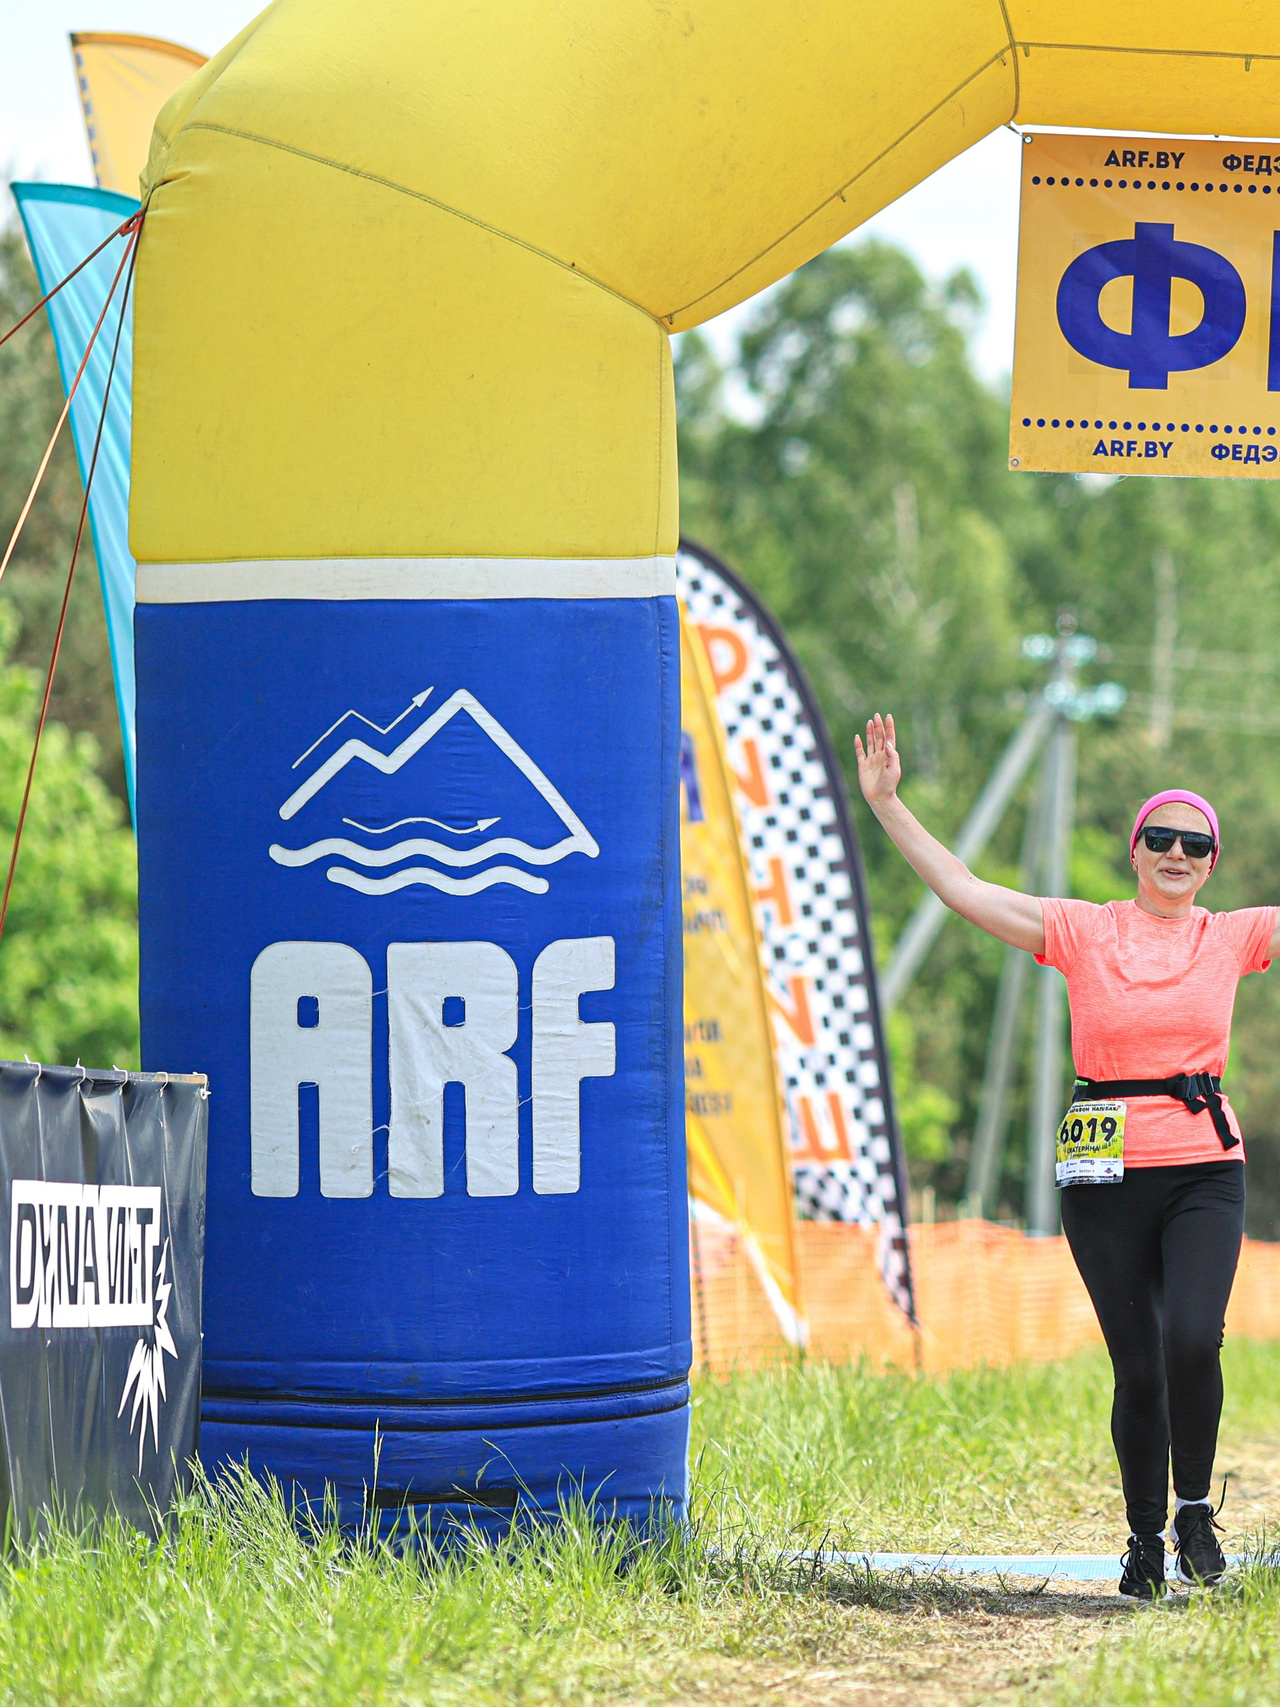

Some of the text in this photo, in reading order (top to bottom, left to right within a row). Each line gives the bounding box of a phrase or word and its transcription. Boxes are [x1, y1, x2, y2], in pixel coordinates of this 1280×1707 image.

[1104, 149, 1186, 170] ARF.BY
[1092, 439, 1174, 459] ARF.BY
[250, 935, 616, 1199] ARF
[1060, 1116, 1118, 1145] 6019
